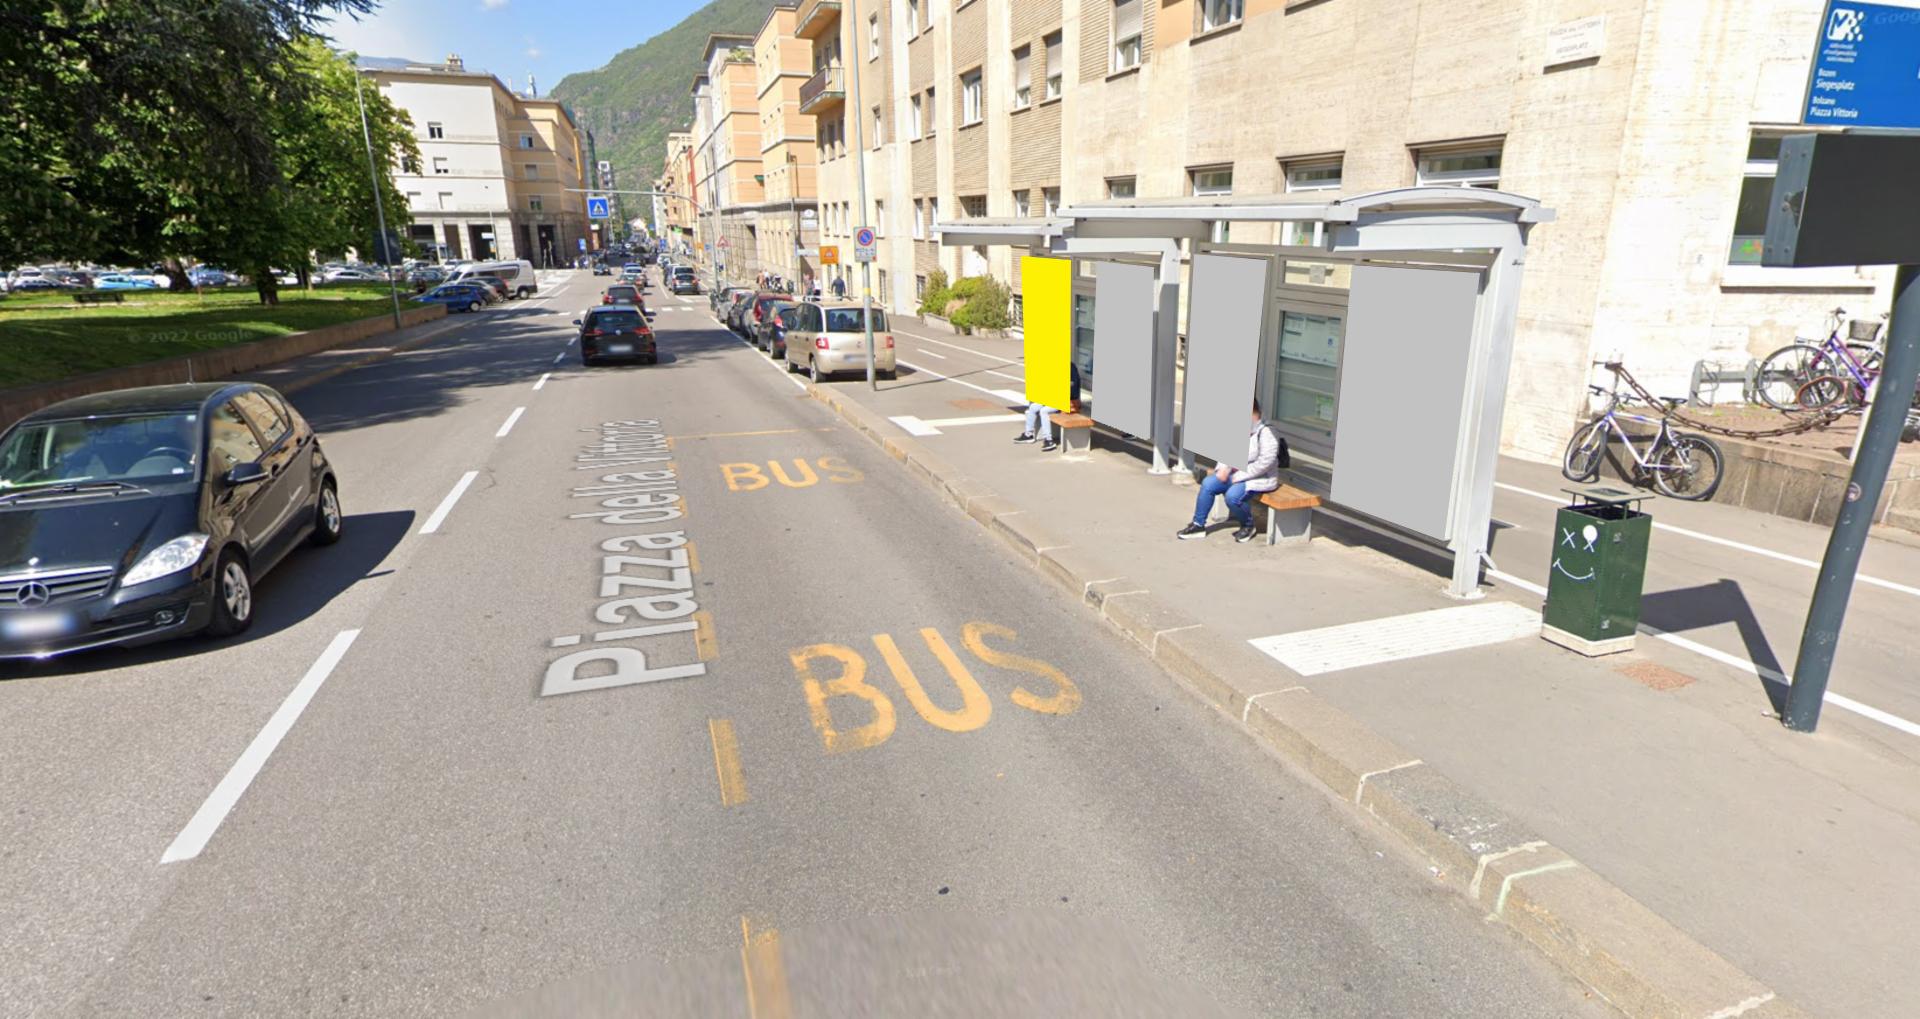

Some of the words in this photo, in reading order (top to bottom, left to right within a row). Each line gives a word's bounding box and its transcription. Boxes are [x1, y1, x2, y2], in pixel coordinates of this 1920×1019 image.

[1816, 78, 1855, 91] Siegesplatz
[1812, 96, 1836, 105] Bolzano
[1810, 106, 1832, 117] Piazza
[1833, 107, 1859, 118] Vittoria
[719, 456, 865, 492] BUS
[789, 620, 1083, 755] BUS
